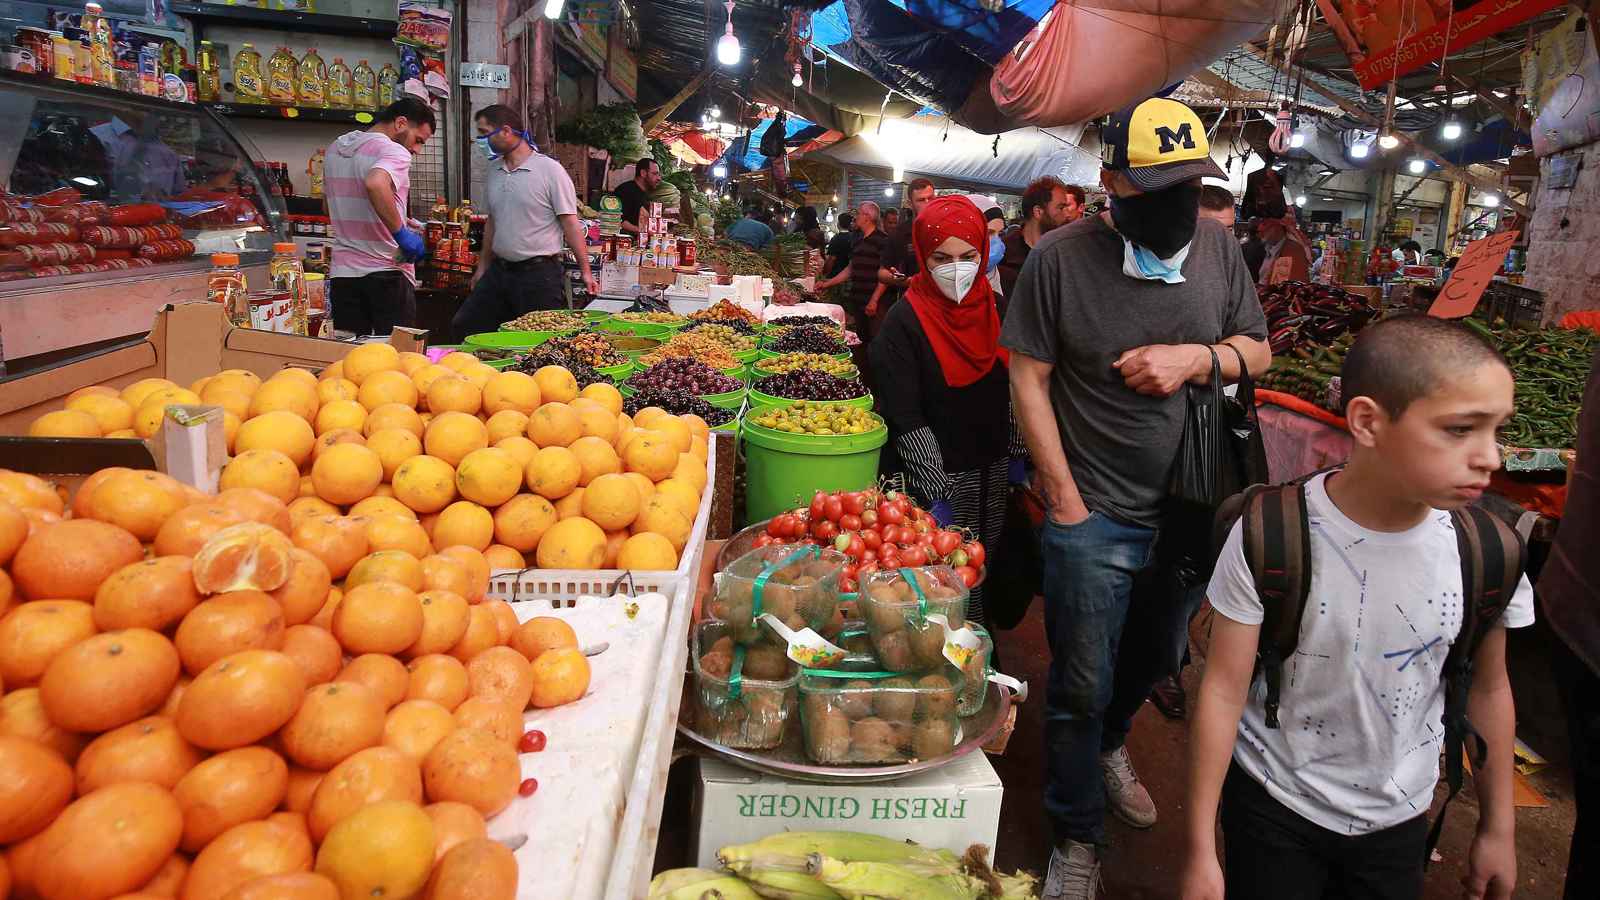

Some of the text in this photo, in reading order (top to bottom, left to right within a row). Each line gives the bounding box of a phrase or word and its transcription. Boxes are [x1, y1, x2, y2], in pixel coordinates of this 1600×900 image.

[1155, 123, 1196, 154] M
[736, 793, 969, 820] FRESH GINGER
